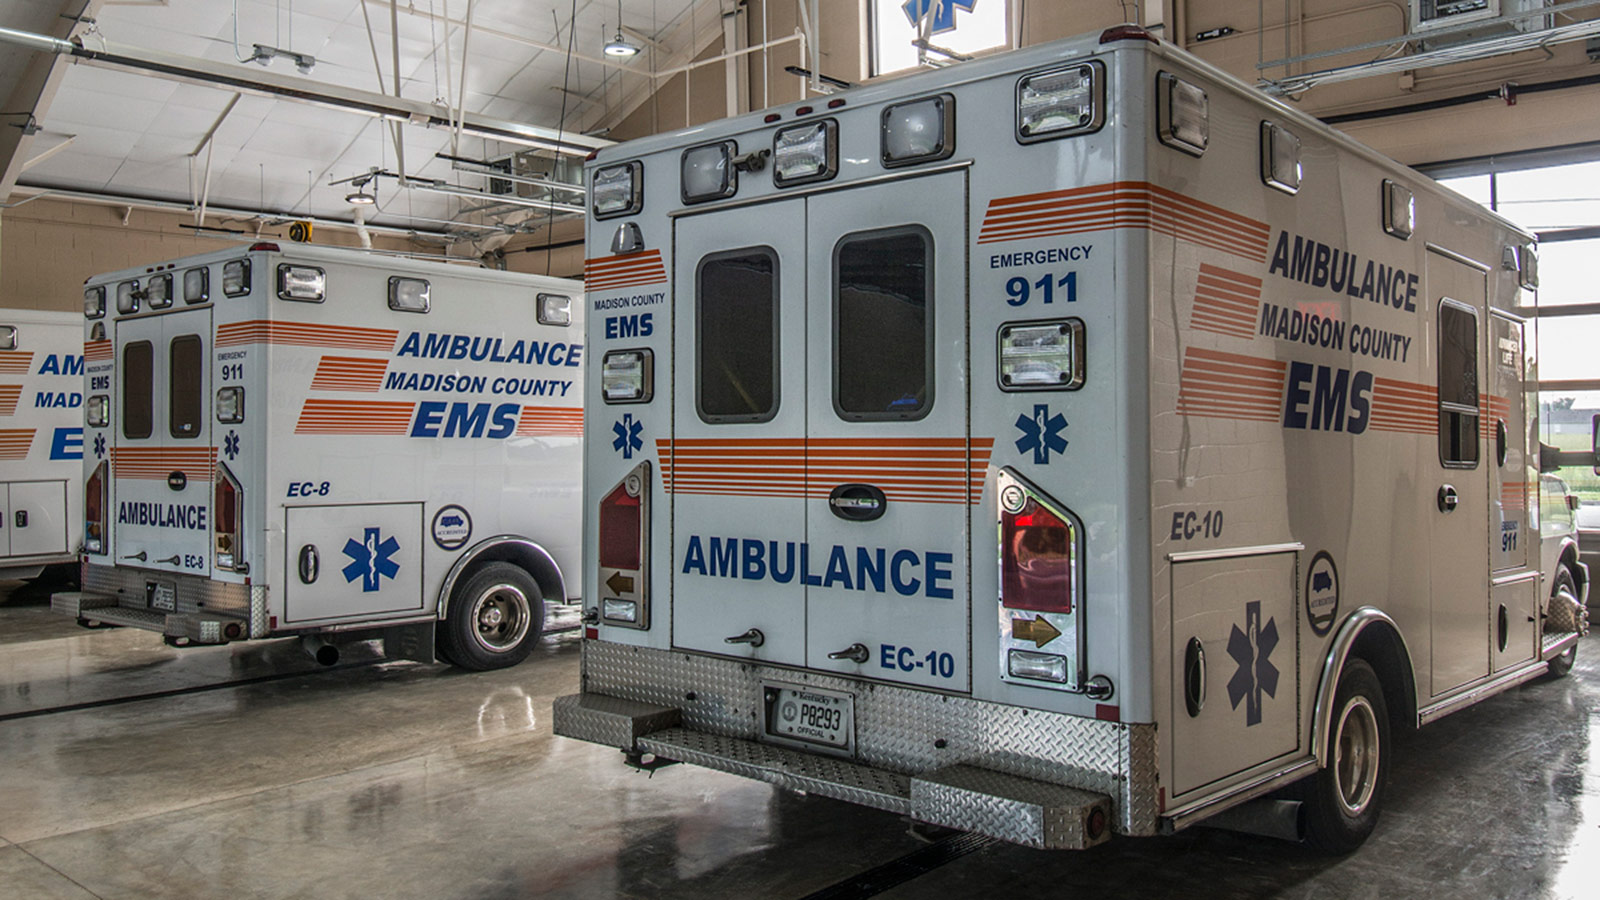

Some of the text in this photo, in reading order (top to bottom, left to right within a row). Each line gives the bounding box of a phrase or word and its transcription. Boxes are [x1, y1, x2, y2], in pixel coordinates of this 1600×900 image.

[990, 245, 1093, 269] EMERGENCY
[1268, 230, 1419, 313] AMBULANCE
[594, 292, 665, 311] MADISON COUNTY
[1005, 271, 1077, 306] 911
[605, 312, 653, 340] EMS
[1259, 302, 1412, 363] MADISON COUNTY
[396, 331, 584, 367] AMBULANCE
[91, 375, 110, 391] EMS
[222, 363, 243, 381] 911
[384, 371, 573, 397] MADISON COUNTY
[1283, 360, 1374, 435] EMS
[410, 401, 521, 439] EMS
[286, 481, 330, 498] EC-8
[118, 501, 207, 531] AMBULANCE
[1170, 510, 1223, 541] EC-10
[1501, 531, 1517, 552] 911
[184, 554, 204, 569] EC-8
[682, 535, 954, 600] AMBULANCE
[880, 643, 955, 679] EC-10
[799, 692, 831, 706] Kentucky
[800, 703, 842, 732] P8293
[797, 726, 825, 738] OFFICIAL
